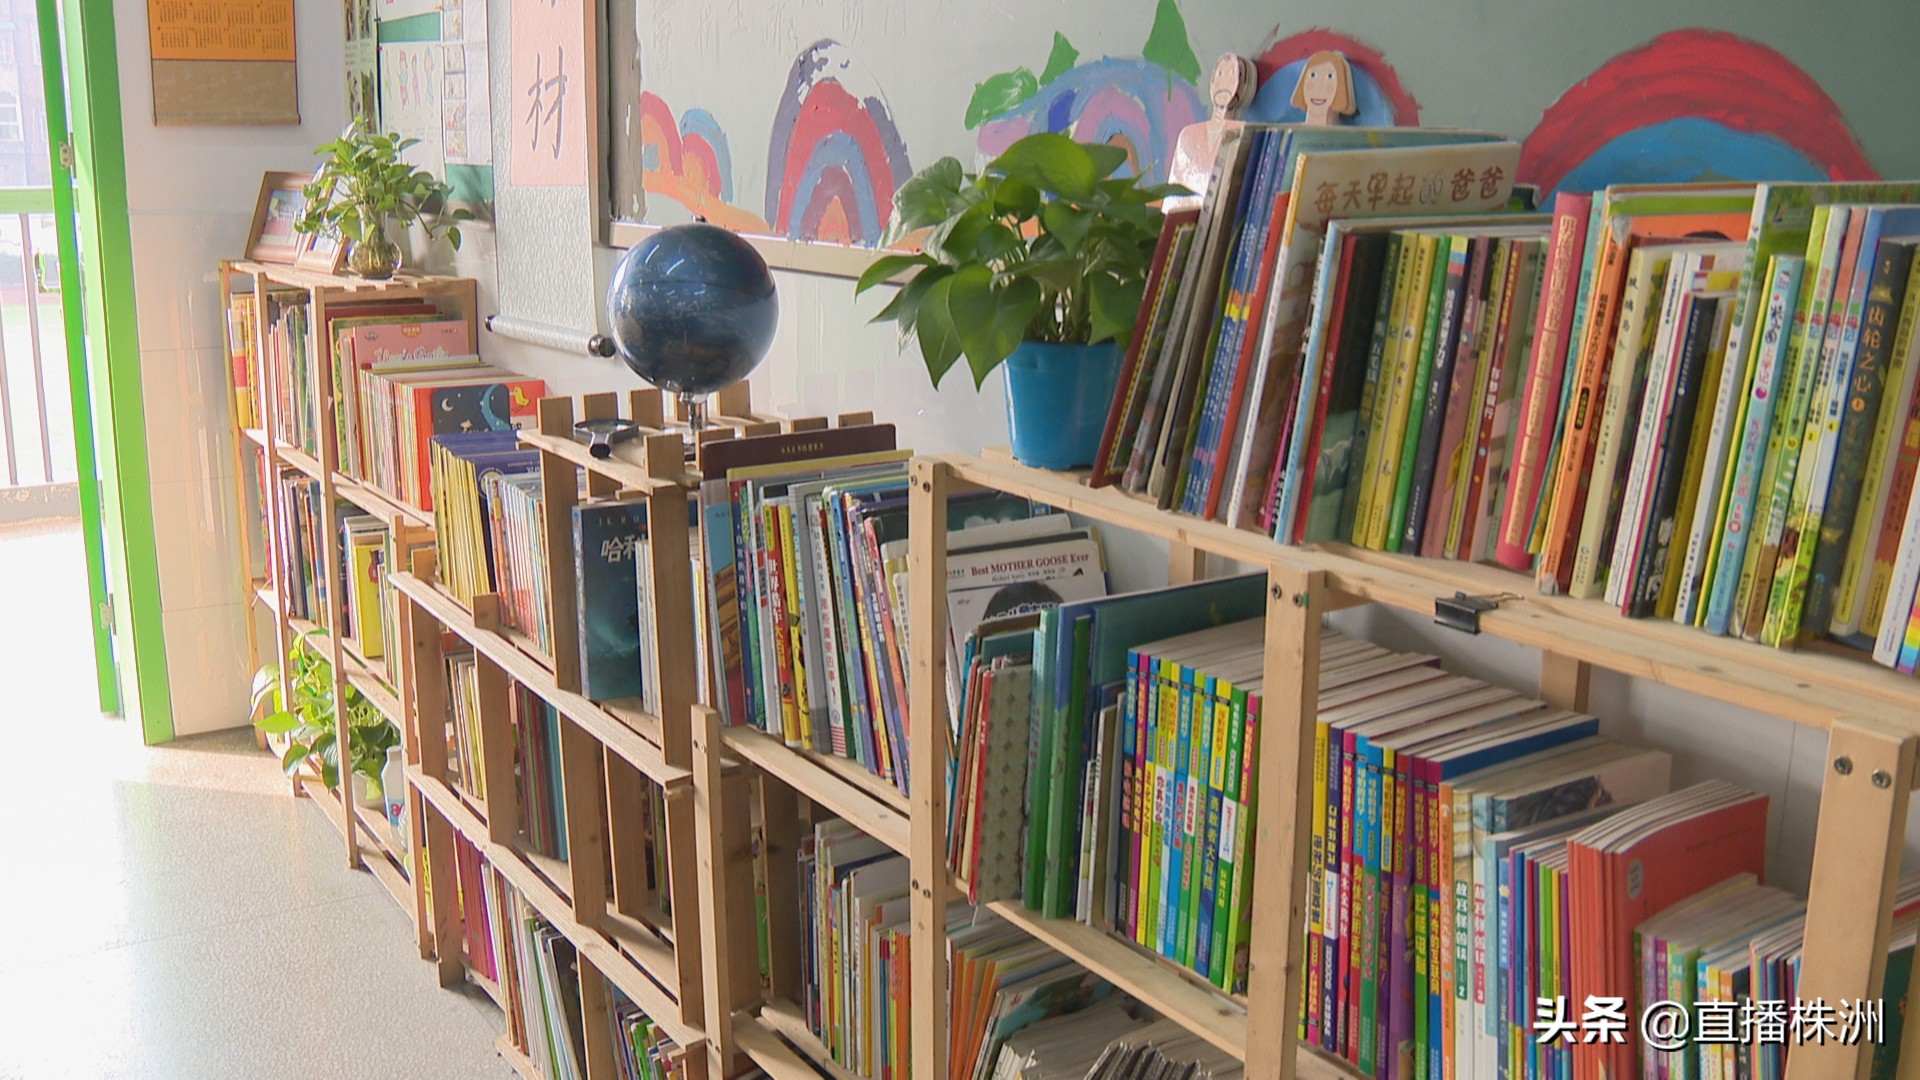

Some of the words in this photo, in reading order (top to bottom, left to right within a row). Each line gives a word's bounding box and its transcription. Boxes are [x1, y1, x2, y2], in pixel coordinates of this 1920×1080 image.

[525, 46, 567, 159] 材
[1314, 165, 1504, 214] 每天早起的爸爸
[1854, 306, 1886, 392] 齿轮之心
[971, 564, 989, 577] Best
[991, 559, 1034, 574] MOTHER
[1035, 554, 1069, 568] GOOSE
[1070, 552, 1090, 564] Ever
